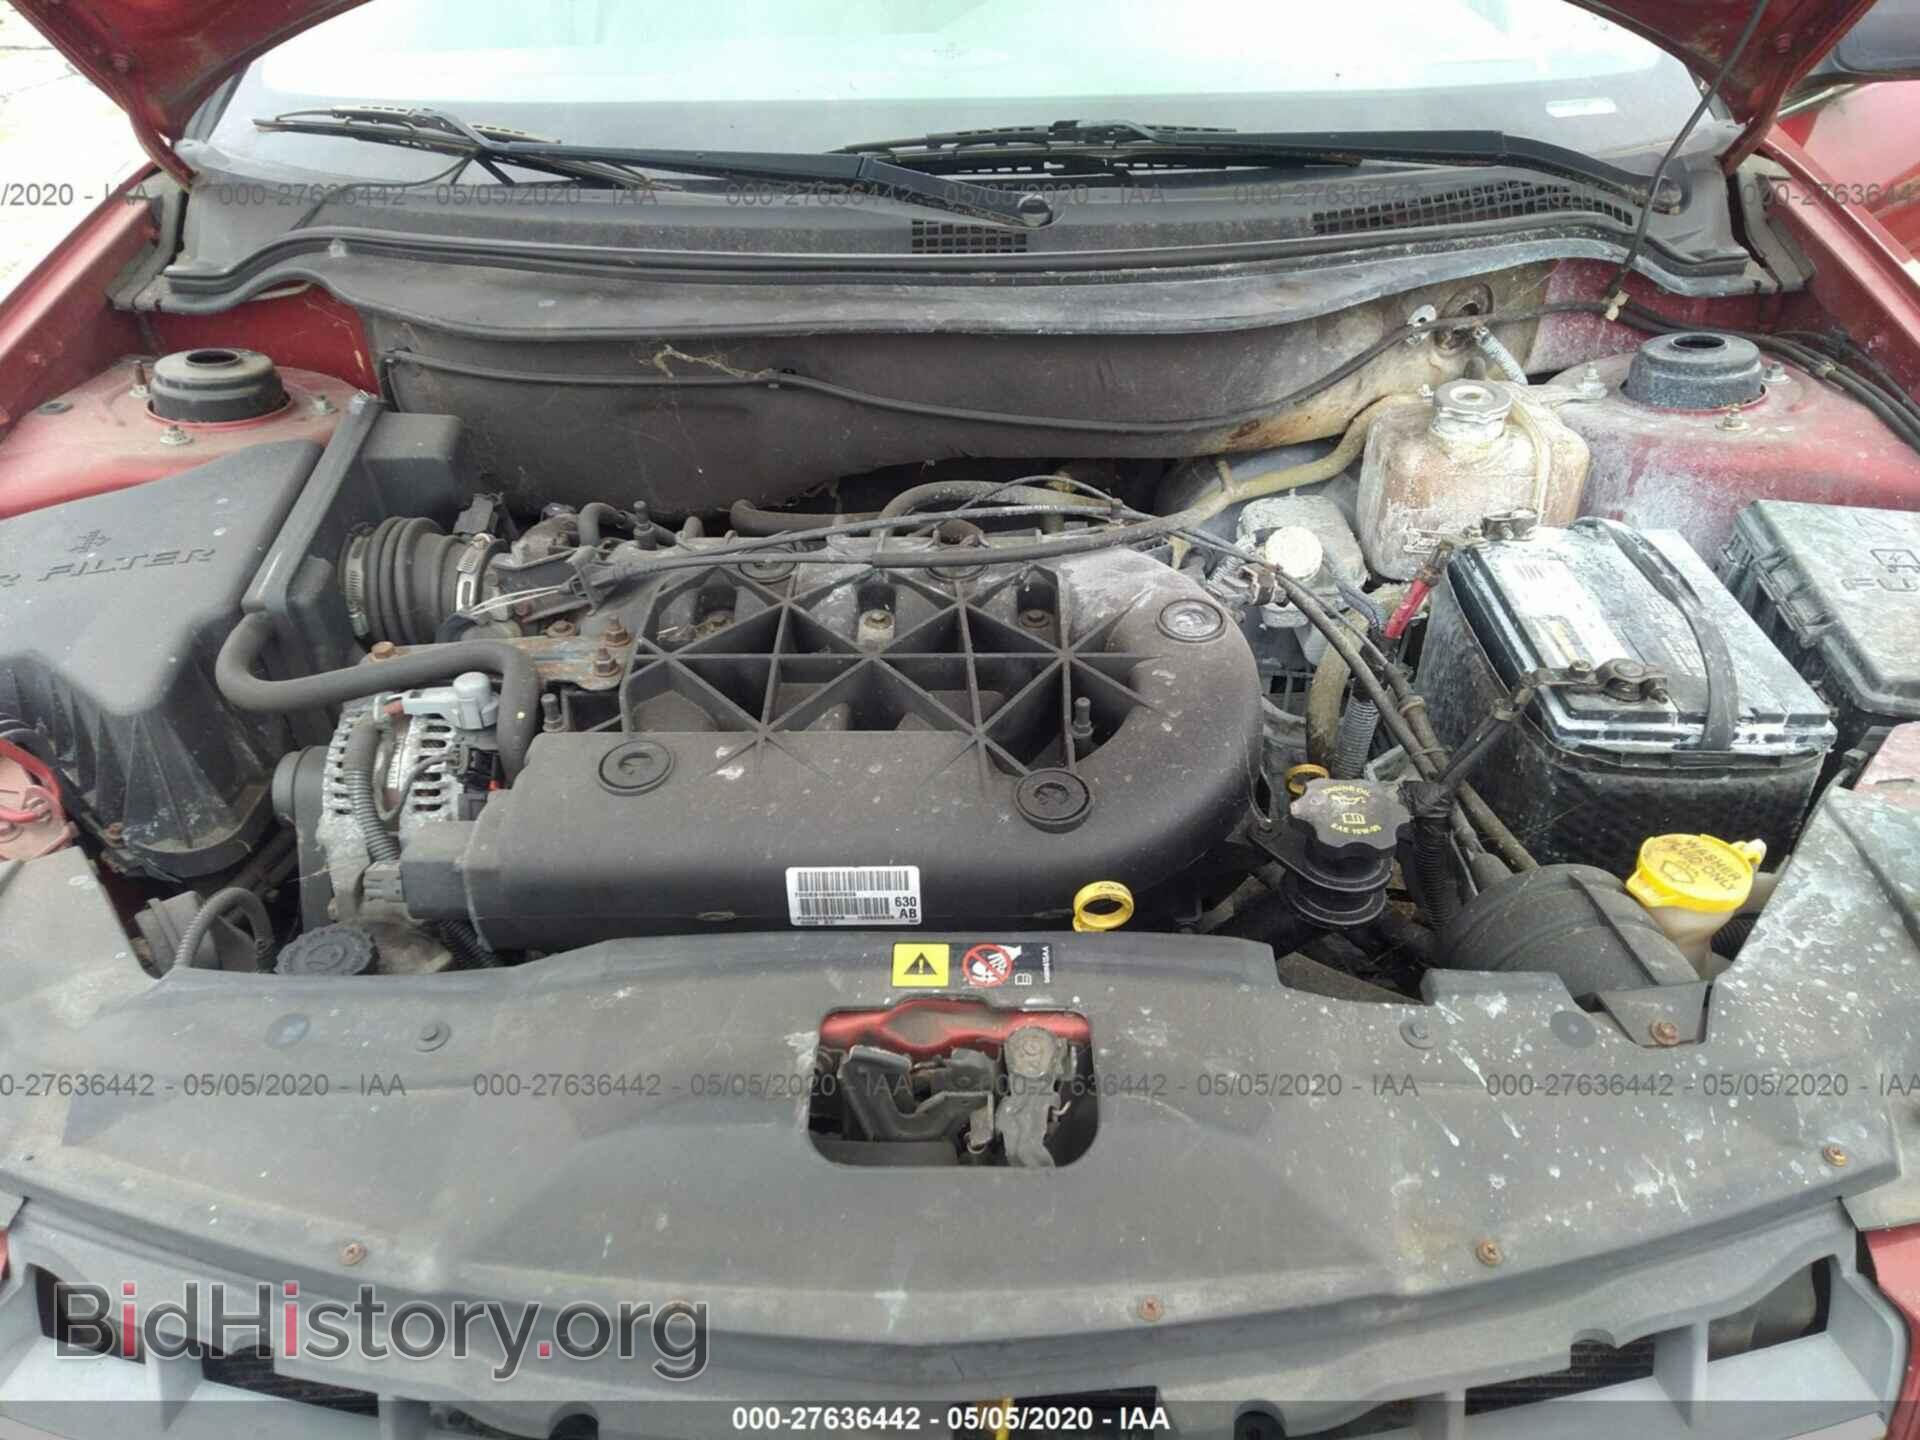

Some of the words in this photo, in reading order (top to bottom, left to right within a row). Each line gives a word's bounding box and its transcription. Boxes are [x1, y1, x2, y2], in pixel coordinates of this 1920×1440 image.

[37, 548, 215, 582] FILTER
[895, 896, 917, 908] 630
[899, 908, 917, 919] AB
